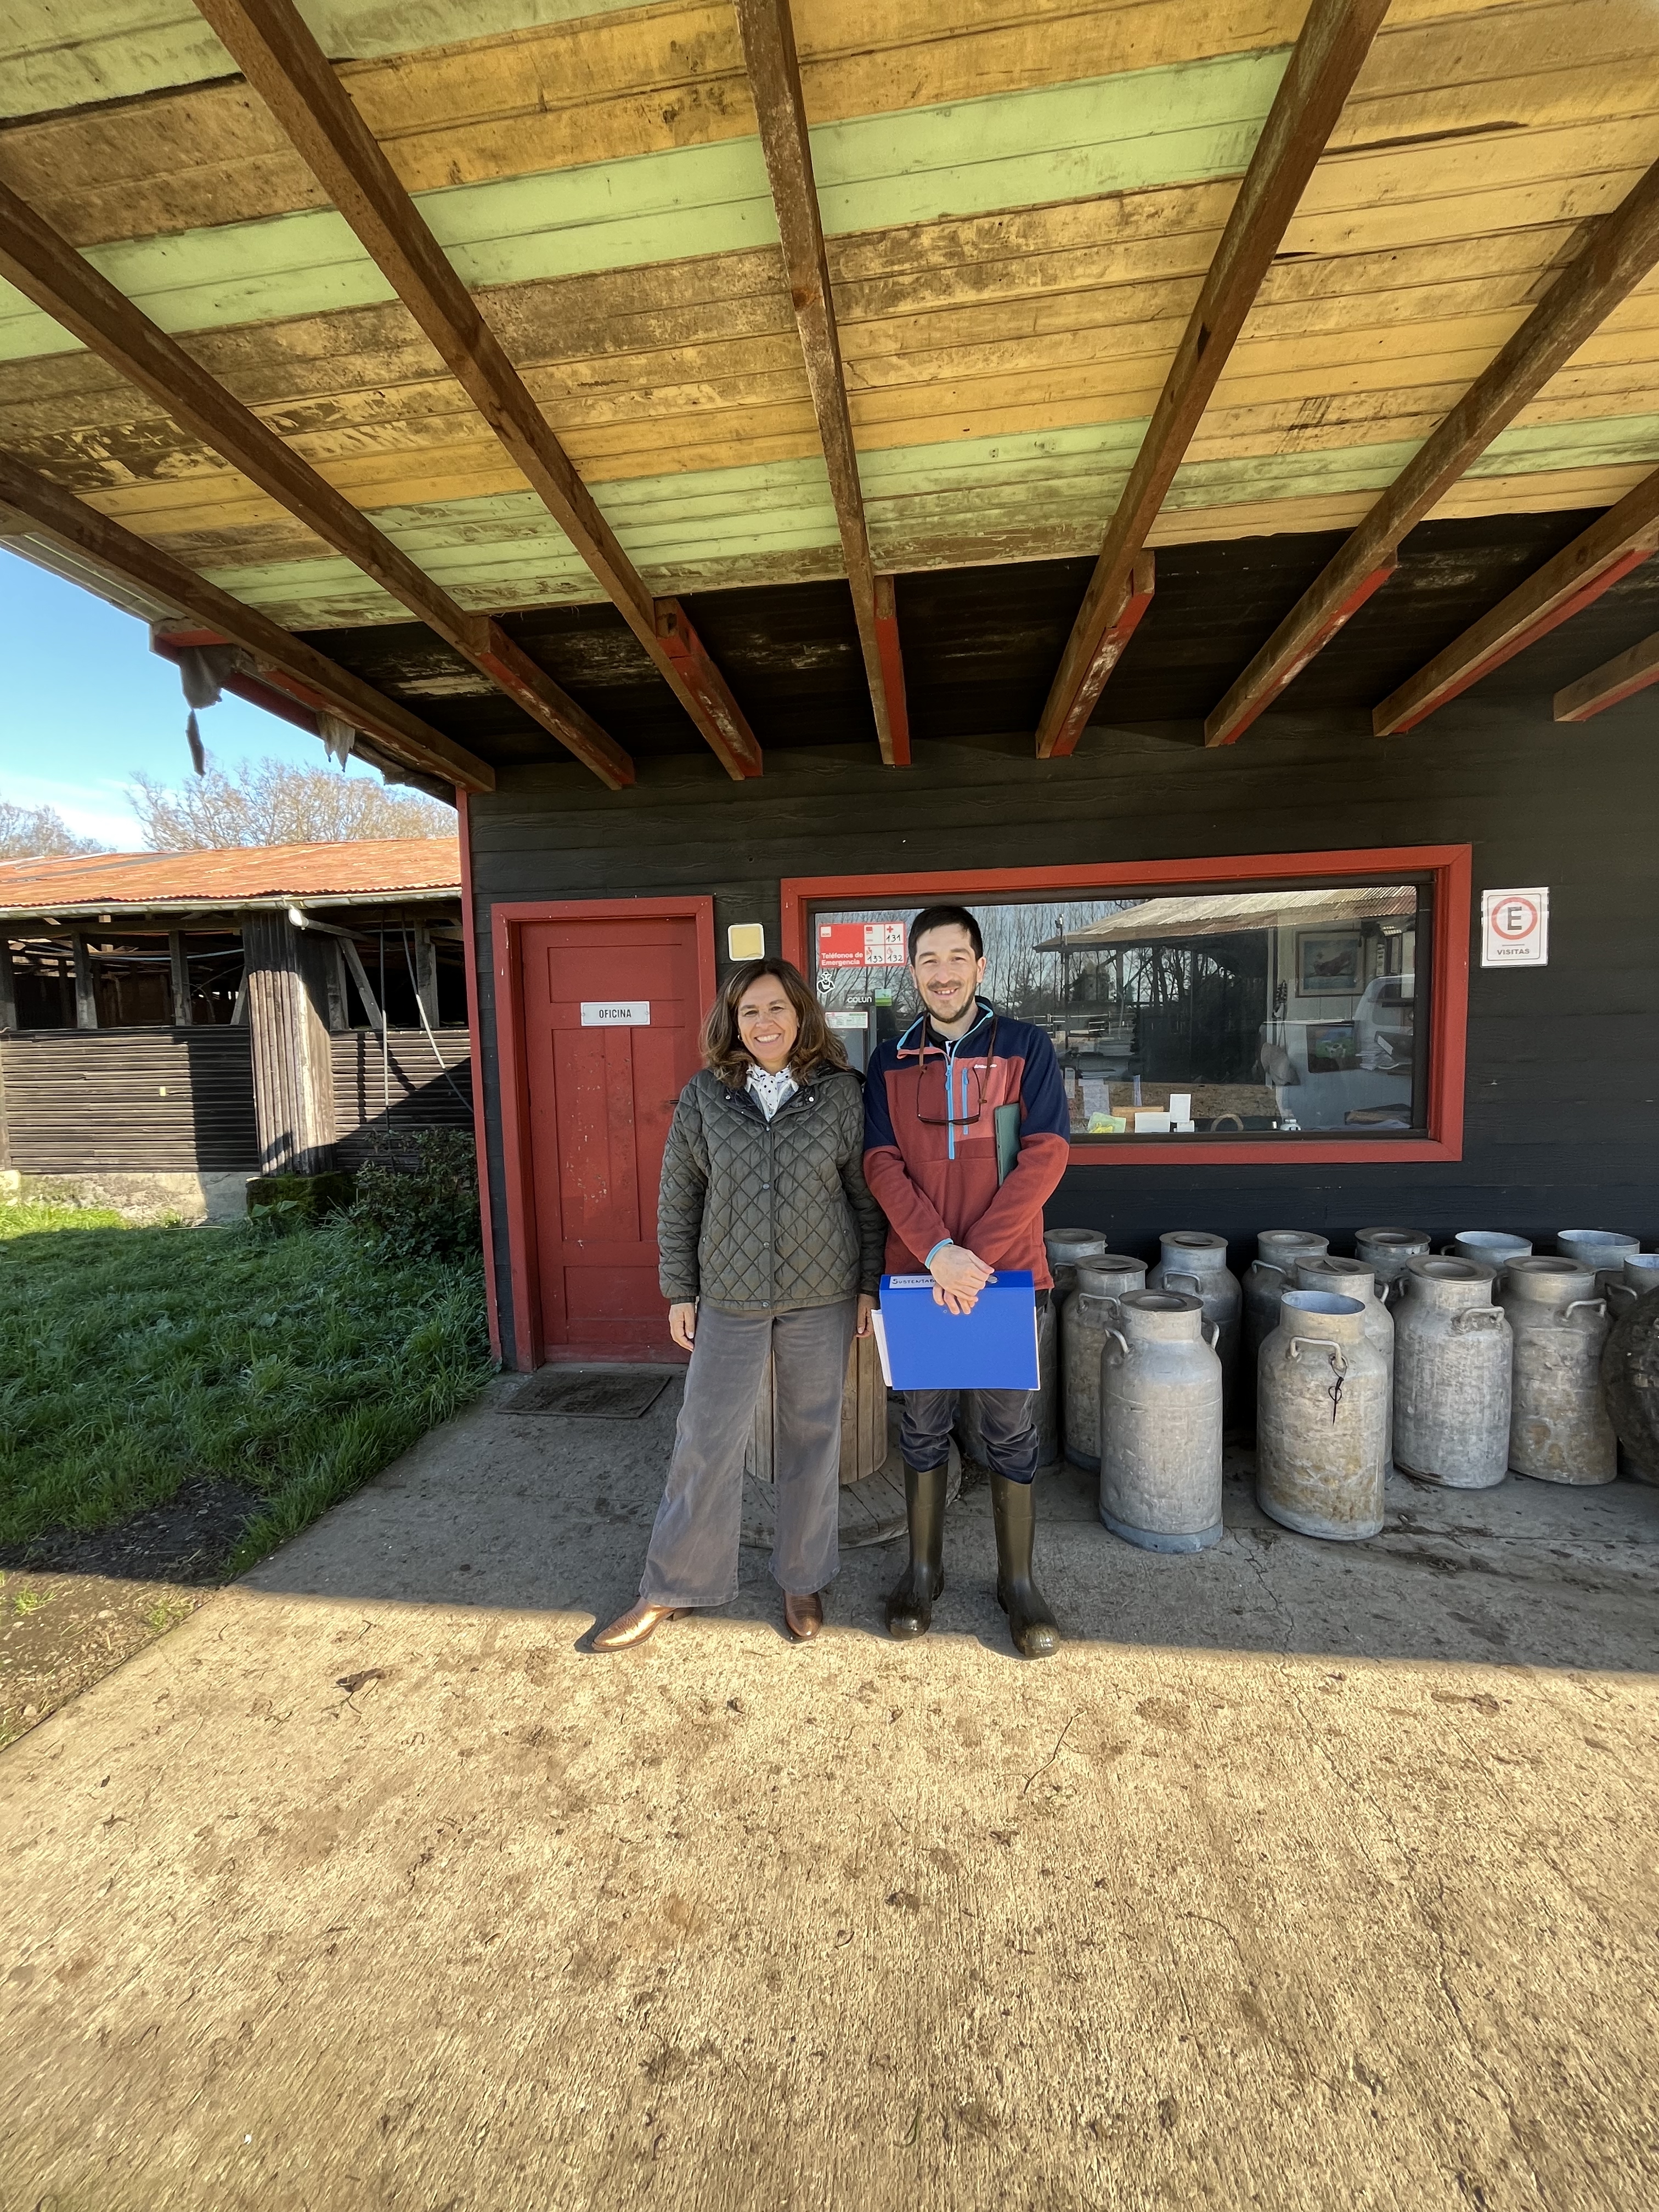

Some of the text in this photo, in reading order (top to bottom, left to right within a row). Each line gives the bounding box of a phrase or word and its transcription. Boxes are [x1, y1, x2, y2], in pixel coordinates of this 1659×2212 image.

[1507, 906, 1522, 930] E
[885, 934, 901, 943] 131
[867, 955, 883, 963] 133
[599, 1009, 631, 1018] OFICINA
